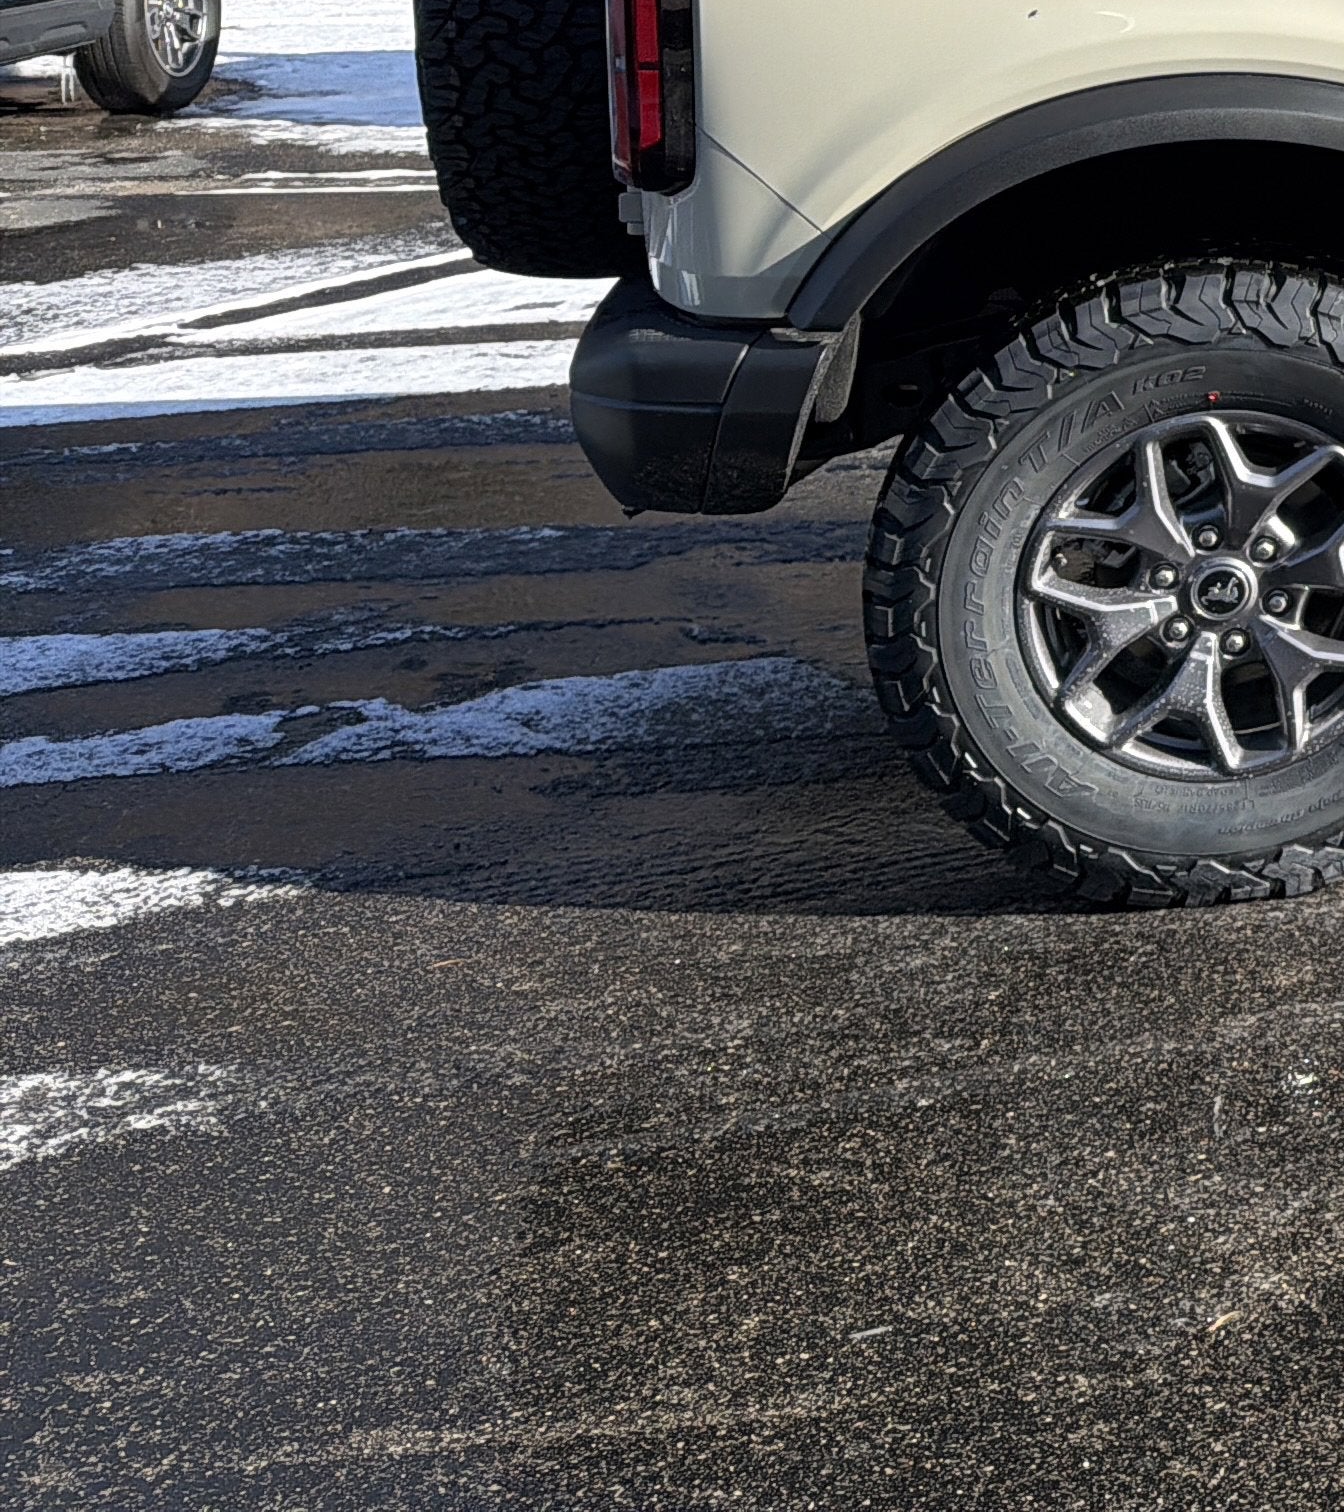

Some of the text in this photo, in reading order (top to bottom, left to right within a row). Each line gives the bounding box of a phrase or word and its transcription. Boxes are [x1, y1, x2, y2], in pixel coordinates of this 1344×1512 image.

[1131, 365, 1207, 394] KO2
[1017, 391, 1126, 472] T/A
[967, 475, 1099, 800] All-Terrain
